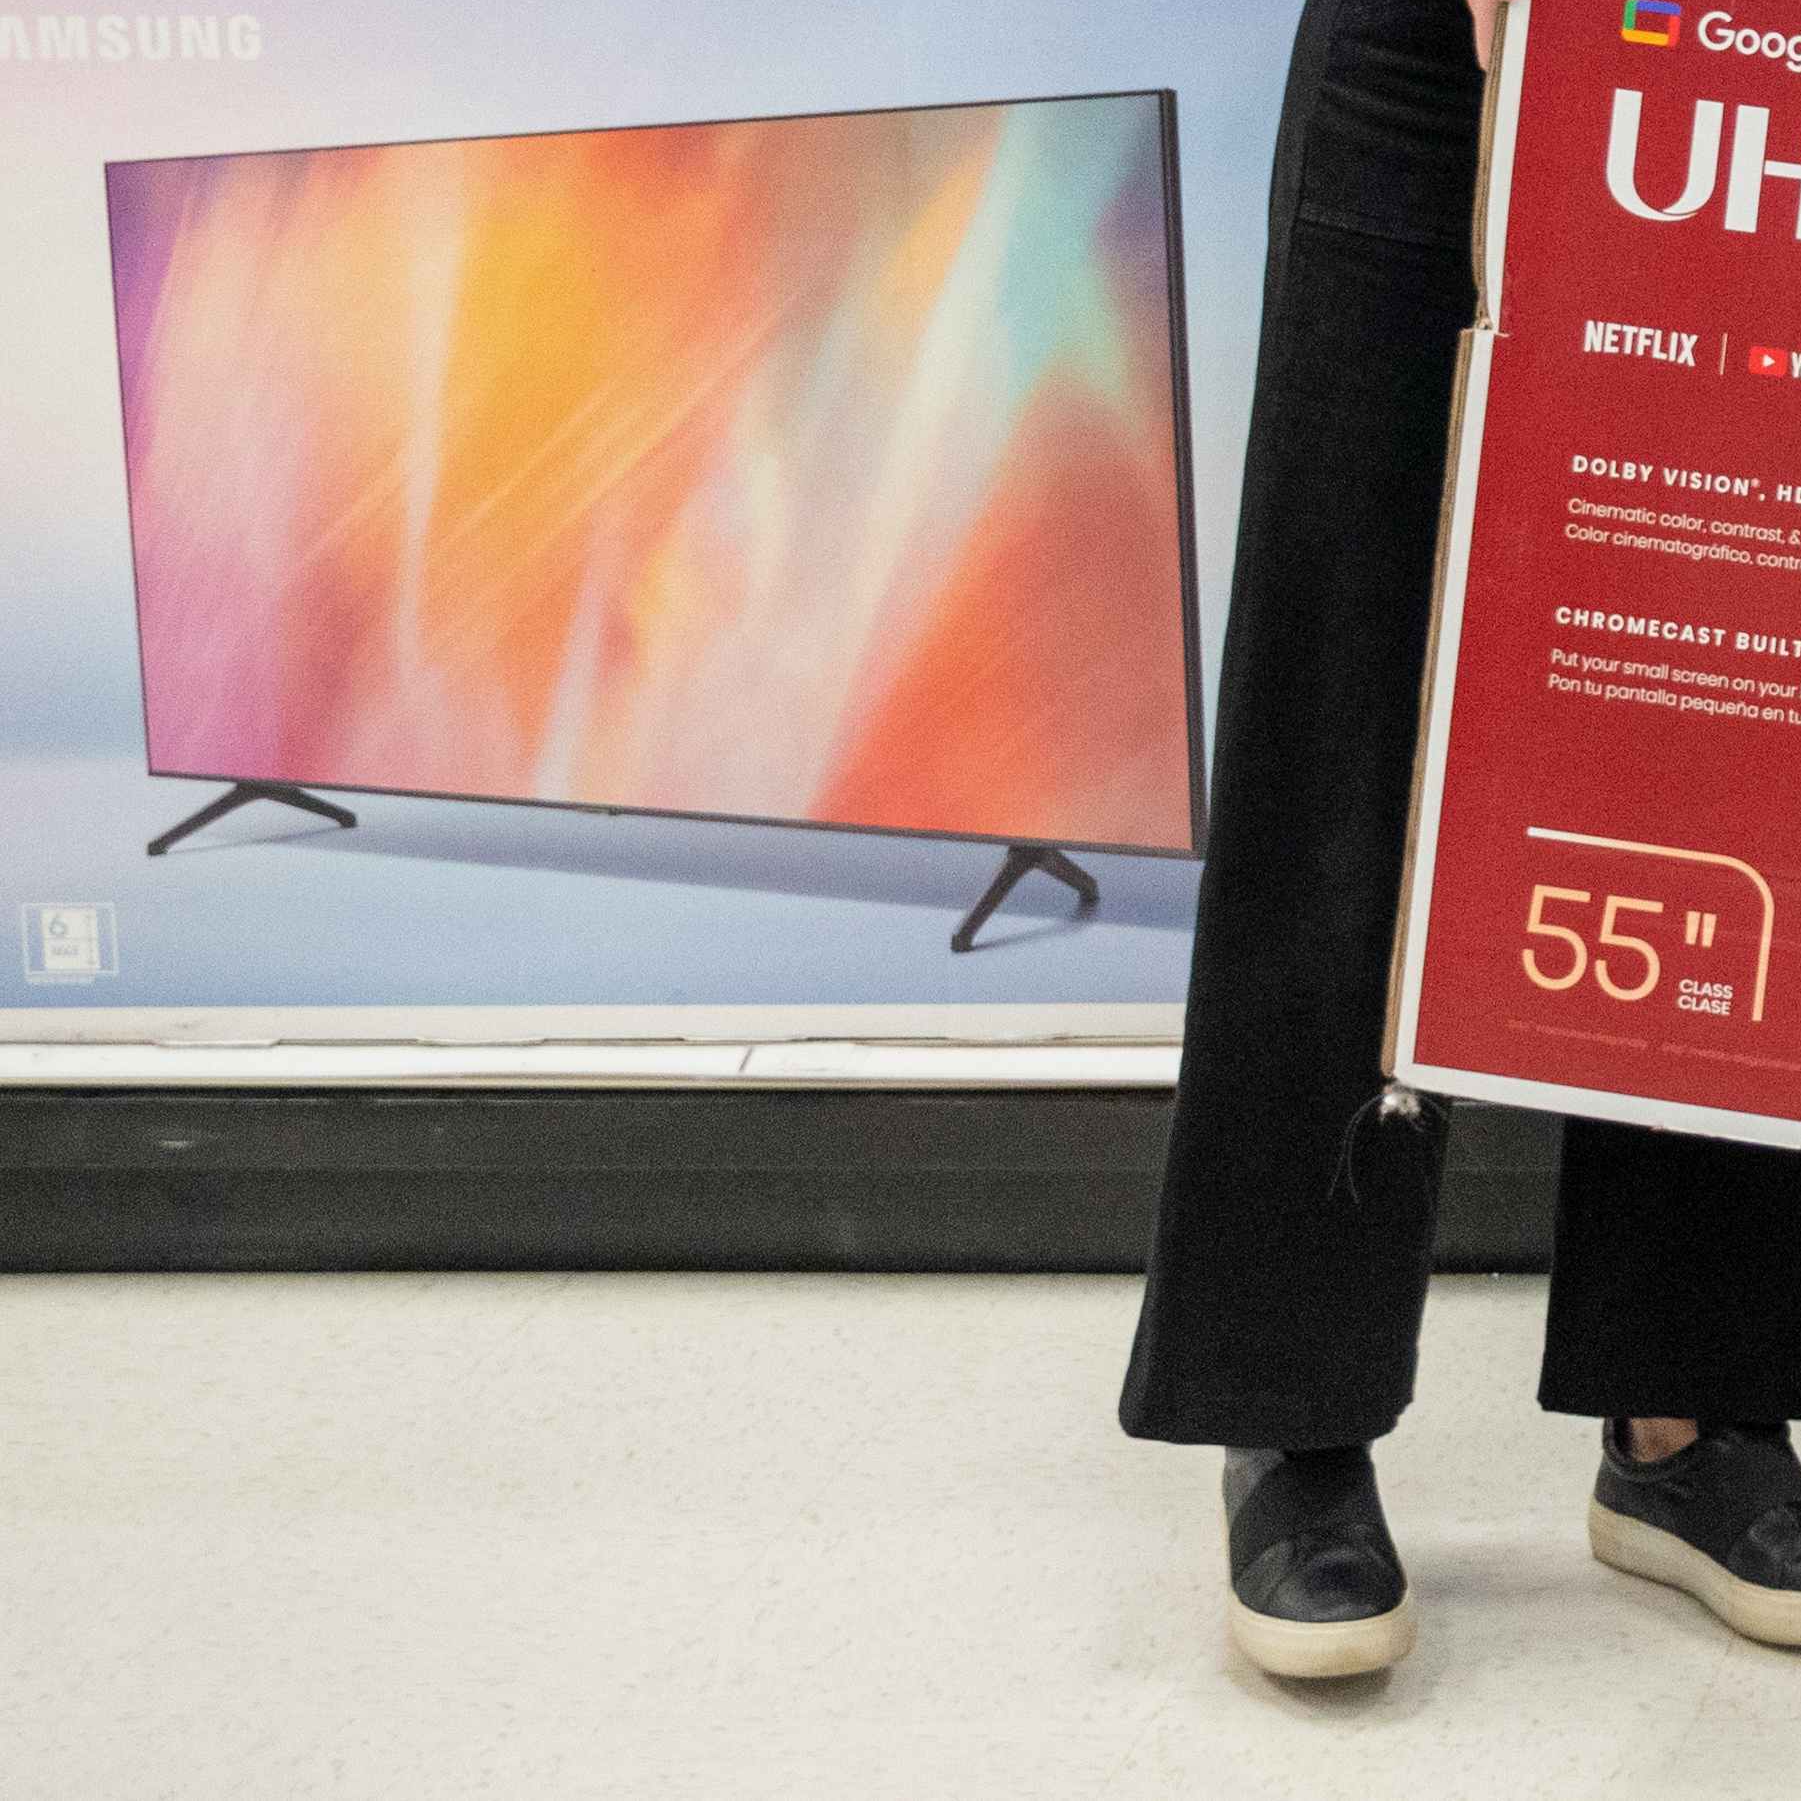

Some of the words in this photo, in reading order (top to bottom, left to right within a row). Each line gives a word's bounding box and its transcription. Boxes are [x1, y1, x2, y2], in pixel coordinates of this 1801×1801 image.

[0, 14, 263, 61] AMSUNG
[1583, 319, 1699, 367] NETFLIX
[1571, 454, 1656, 484] DOLBY
[1565, 523, 1609, 546] Color
[1567, 497, 1657, 528] Cinematic
[1659, 510, 1709, 535] color,
[1710, 517, 1787, 545] contrast,
[1788, 529, 1801, 546] &
[1553, 605, 1727, 647] CHROMECAST
[1547, 672, 1582, 694] Pon
[1582, 678, 1603, 697] tu
[1603, 682, 1678, 708] pantalla
[1679, 694, 1760, 721] pequeña
[1761, 706, 1786, 722] en
[1550, 647, 1580, 666] Put
[1581, 654, 1621, 673] your
[1622, 657, 1670, 680] small
[1671, 666, 1730, 690] screen
[1731, 677, 1757, 693] on
[1758, 678, 1798, 701] your
[1520, 883, 1718, 1002] 55"
[1676, 994, 1731, 1017] CLASE
[1678, 978, 1734, 1000] CLASS
